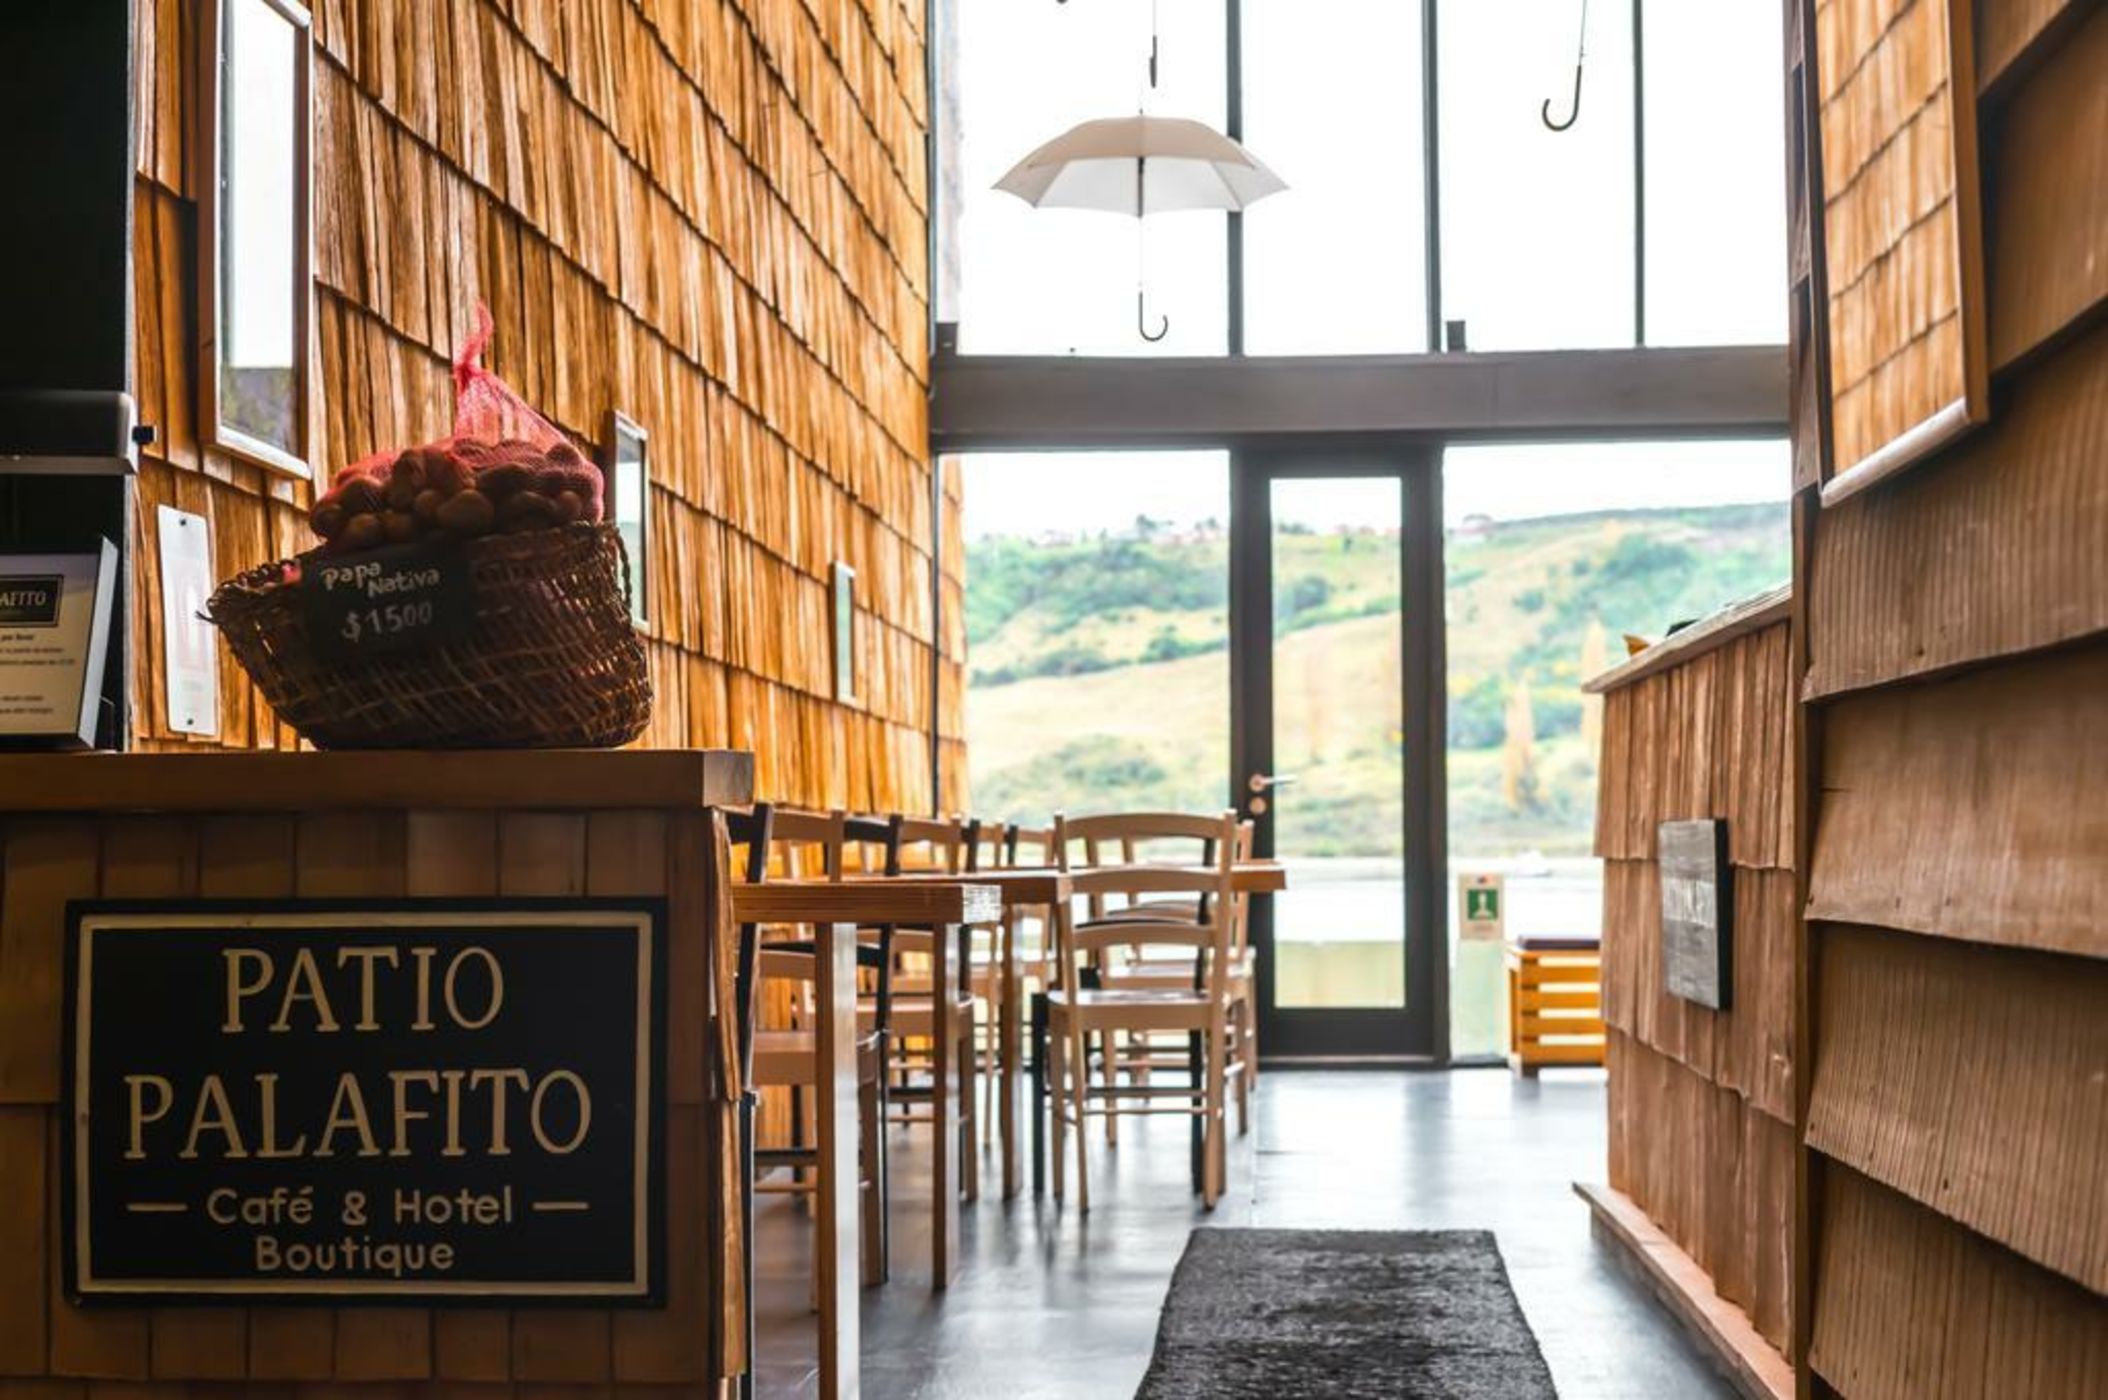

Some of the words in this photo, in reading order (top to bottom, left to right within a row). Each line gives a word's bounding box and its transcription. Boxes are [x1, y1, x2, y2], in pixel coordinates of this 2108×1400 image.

[367, 569, 440, 598] Nativa
[342, 602, 432, 643] $1500
[222, 946, 503, 1032] PATIO
[123, 1069, 592, 1159] PALAFITO
[206, 1185, 314, 1224] Café
[341, 1192, 367, 1225] &
[395, 1185, 512, 1224] Hotel
[255, 1235, 455, 1276] Boutique
